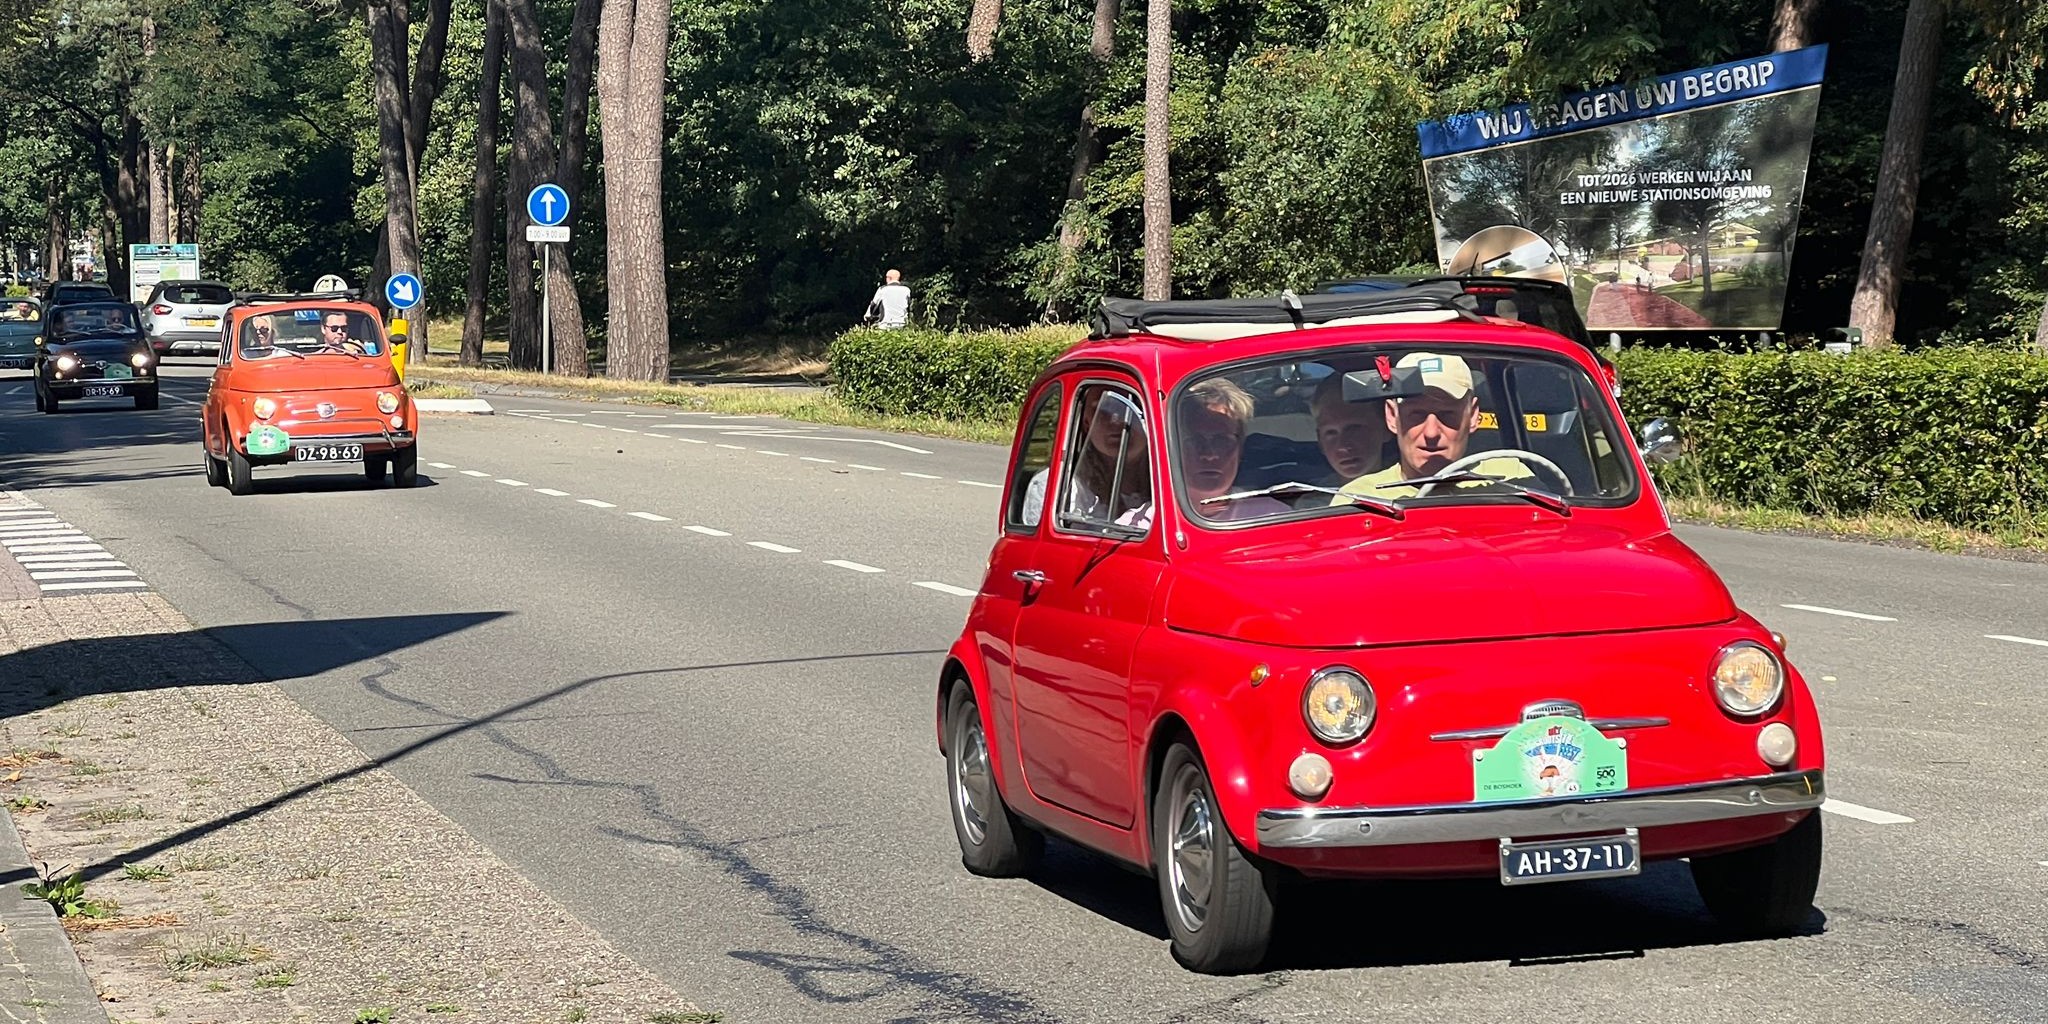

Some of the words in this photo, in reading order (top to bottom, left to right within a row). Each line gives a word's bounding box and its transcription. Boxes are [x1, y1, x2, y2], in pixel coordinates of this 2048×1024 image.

[1476, 110, 1522, 140] WIJ
[1635, 79, 1677, 110] UW
[1684, 60, 1775, 102] BEGRIP
[1577, 174, 1600, 187] TOT
[1602, 172, 1636, 186] 2026
[1639, 170, 1694, 185] WERKEN
[1697, 169, 1720, 183] WIJ
[1722, 168, 1752, 182] AAN
[1560, 191, 1586, 205] EEN
[1588, 189, 1638, 204] NIEUWE
[1641, 184, 1773, 202] STATIONSOMGEVING
[298, 446, 360, 461] DZ-98-69
[1596, 768, 1616, 780] 500
[1517, 844, 1624, 876] AH-37-11
